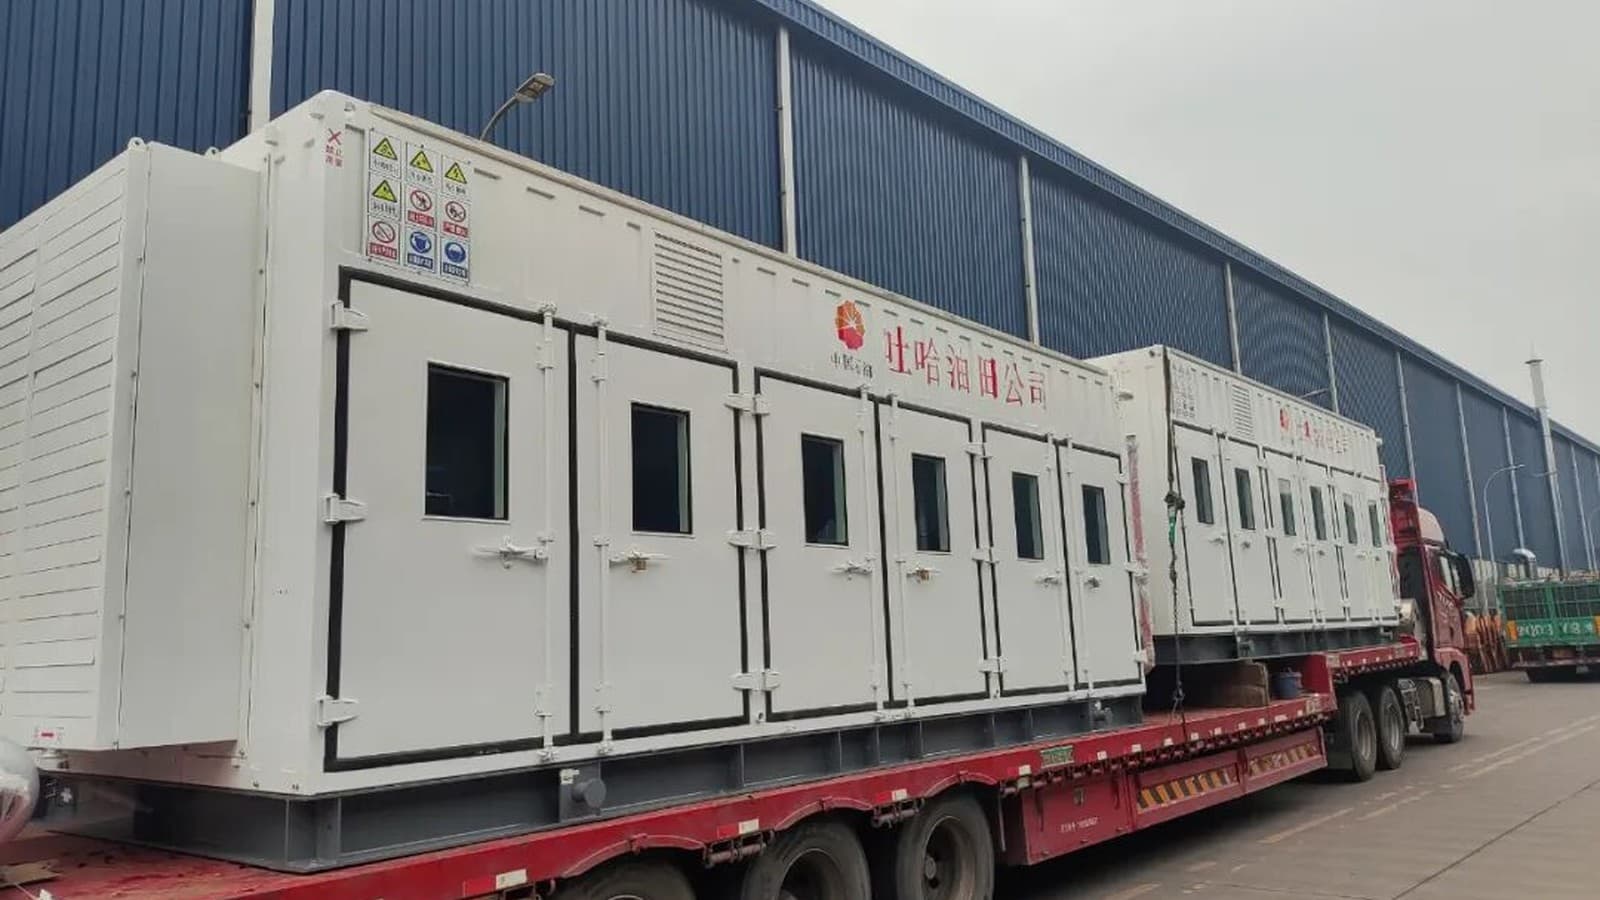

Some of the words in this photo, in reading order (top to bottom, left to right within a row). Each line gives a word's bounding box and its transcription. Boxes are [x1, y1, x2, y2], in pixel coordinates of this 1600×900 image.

[883, 325, 1047, 410] 吐哈油田公司
